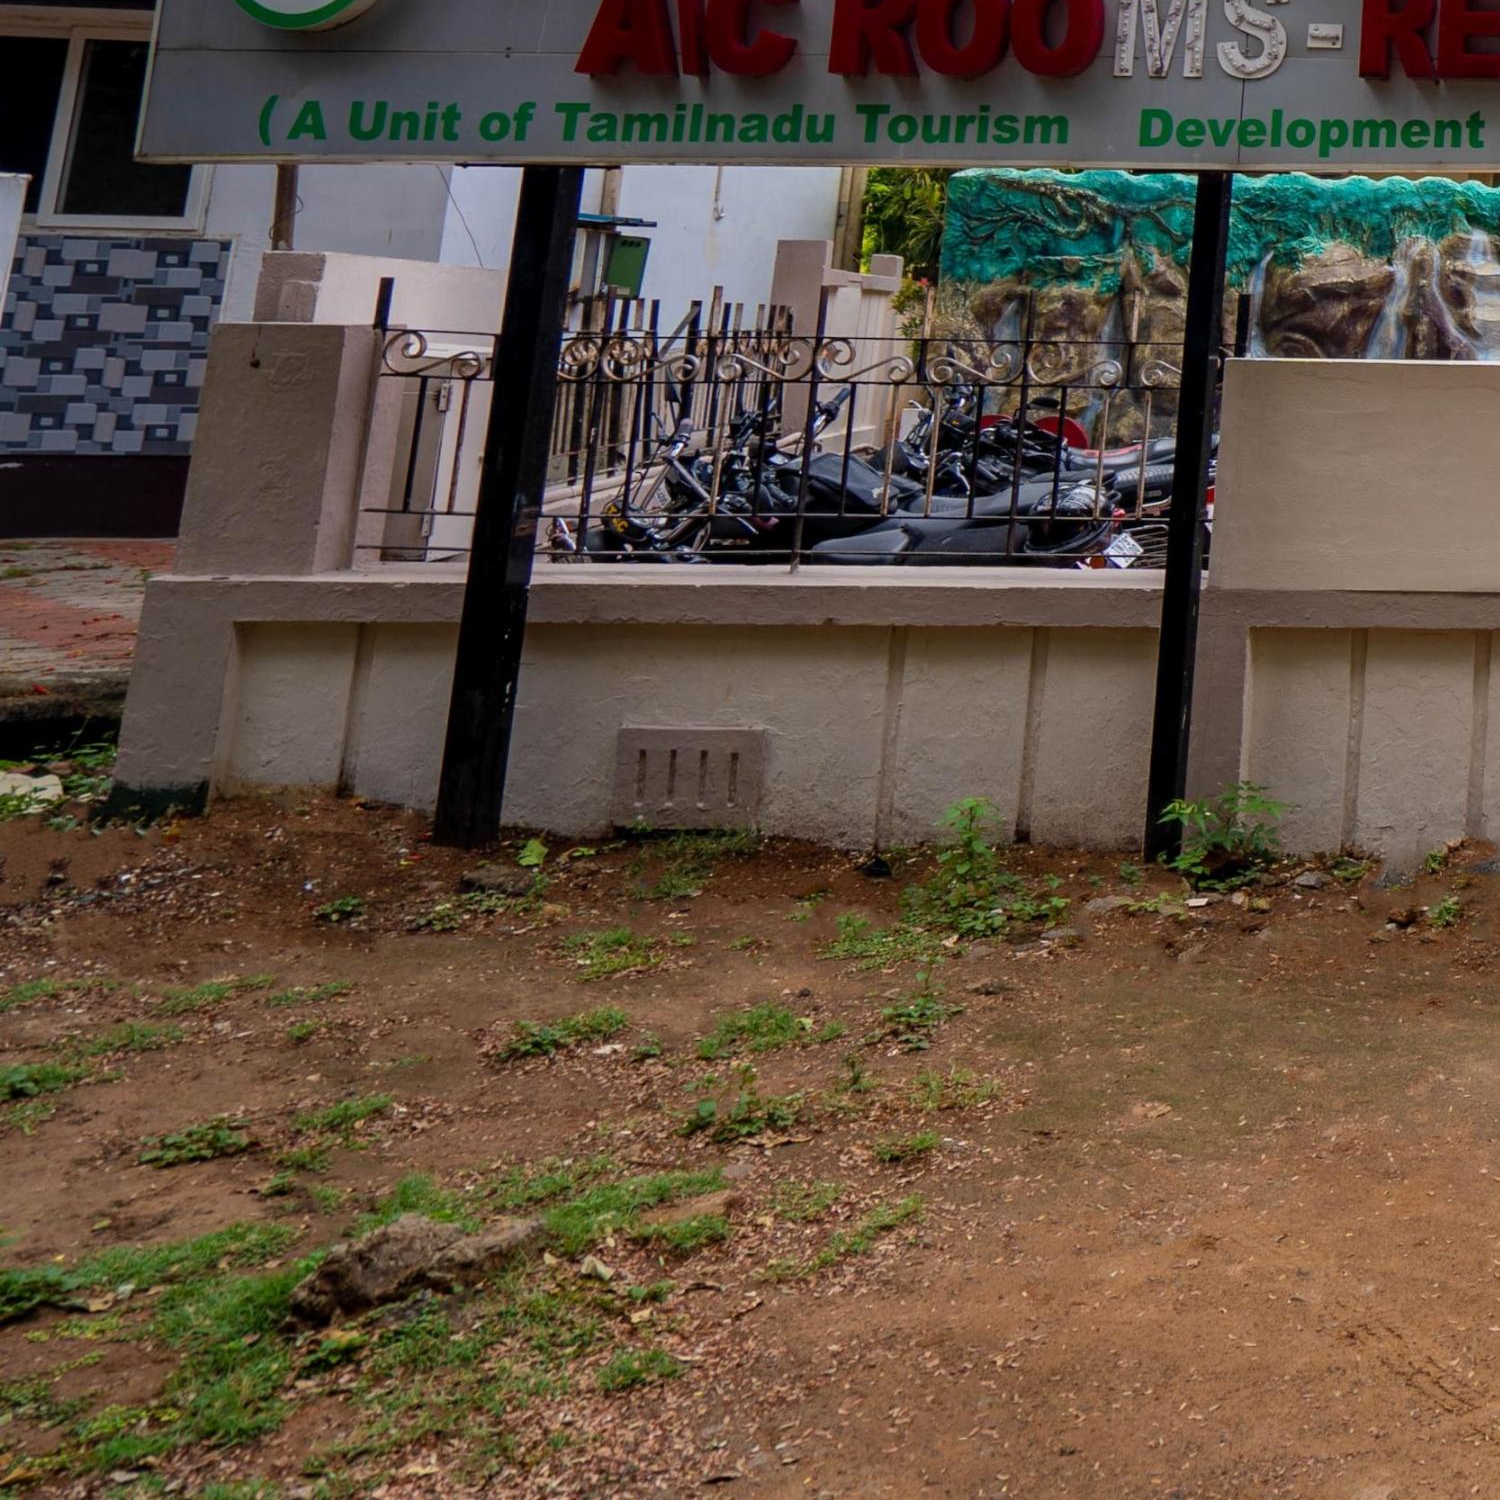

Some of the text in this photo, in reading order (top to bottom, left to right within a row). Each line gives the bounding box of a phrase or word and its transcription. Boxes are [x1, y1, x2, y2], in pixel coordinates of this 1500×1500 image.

[347, 101, 461, 142] Unit
[478, 101, 536, 142] of
[555, 102, 836, 143] Tamilnadu
[855, 104, 1069, 144] Tourism
[1138, 107, 1485, 157] Development
